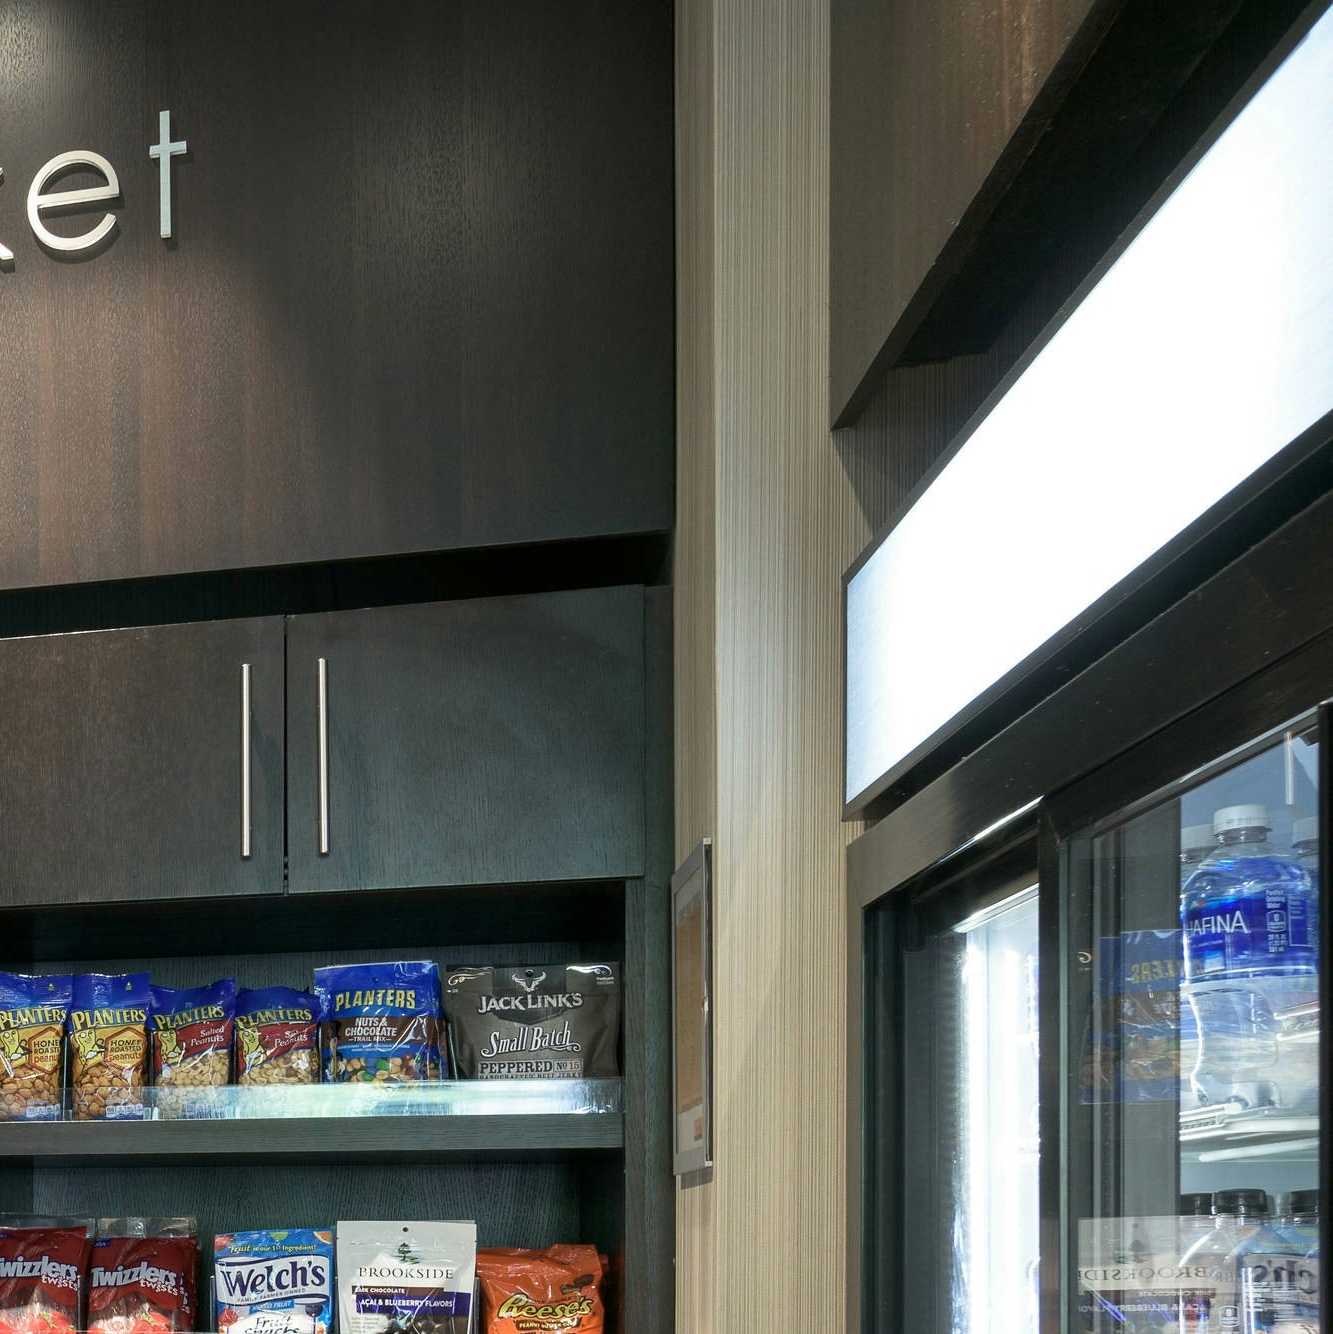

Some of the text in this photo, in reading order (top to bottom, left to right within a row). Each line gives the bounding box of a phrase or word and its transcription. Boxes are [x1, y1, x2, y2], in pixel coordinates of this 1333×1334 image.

[335, 990, 416, 1012] PLANTERS
[478, 992, 583, 1014] JACK LINK'S
[71, 1007, 146, 1029] PLANTERS
[153, 1005, 225, 1029] PLANTERS
[234, 1008, 313, 1029] PLANTERS
[355, 1017, 379, 1027] NUTS
[200, 1026, 225, 1036] Salted
[345, 1027, 397, 1037] CHOCOLATE
[481, 1021, 575, 1058] Small Batch
[109, 1045, 142, 1053] ROASTED
[110, 1039, 142, 1048] HONEY
[190, 1034, 224, 1047] Peanuts
[480, 1061, 580, 1073] PEPPERED 15
[92, 1261, 177, 1288] Twizzlers
[220, 1262, 326, 1296] Welch's
[358, 1267, 454, 1279] BROOKSIDE
[41, 1274, 78, 1291] twists
[140, 1279, 179, 1296] twists
[385, 1299, 453, 1308] BLUEBERRY FLAVORS
[498, 1292, 594, 1320] Reese's
